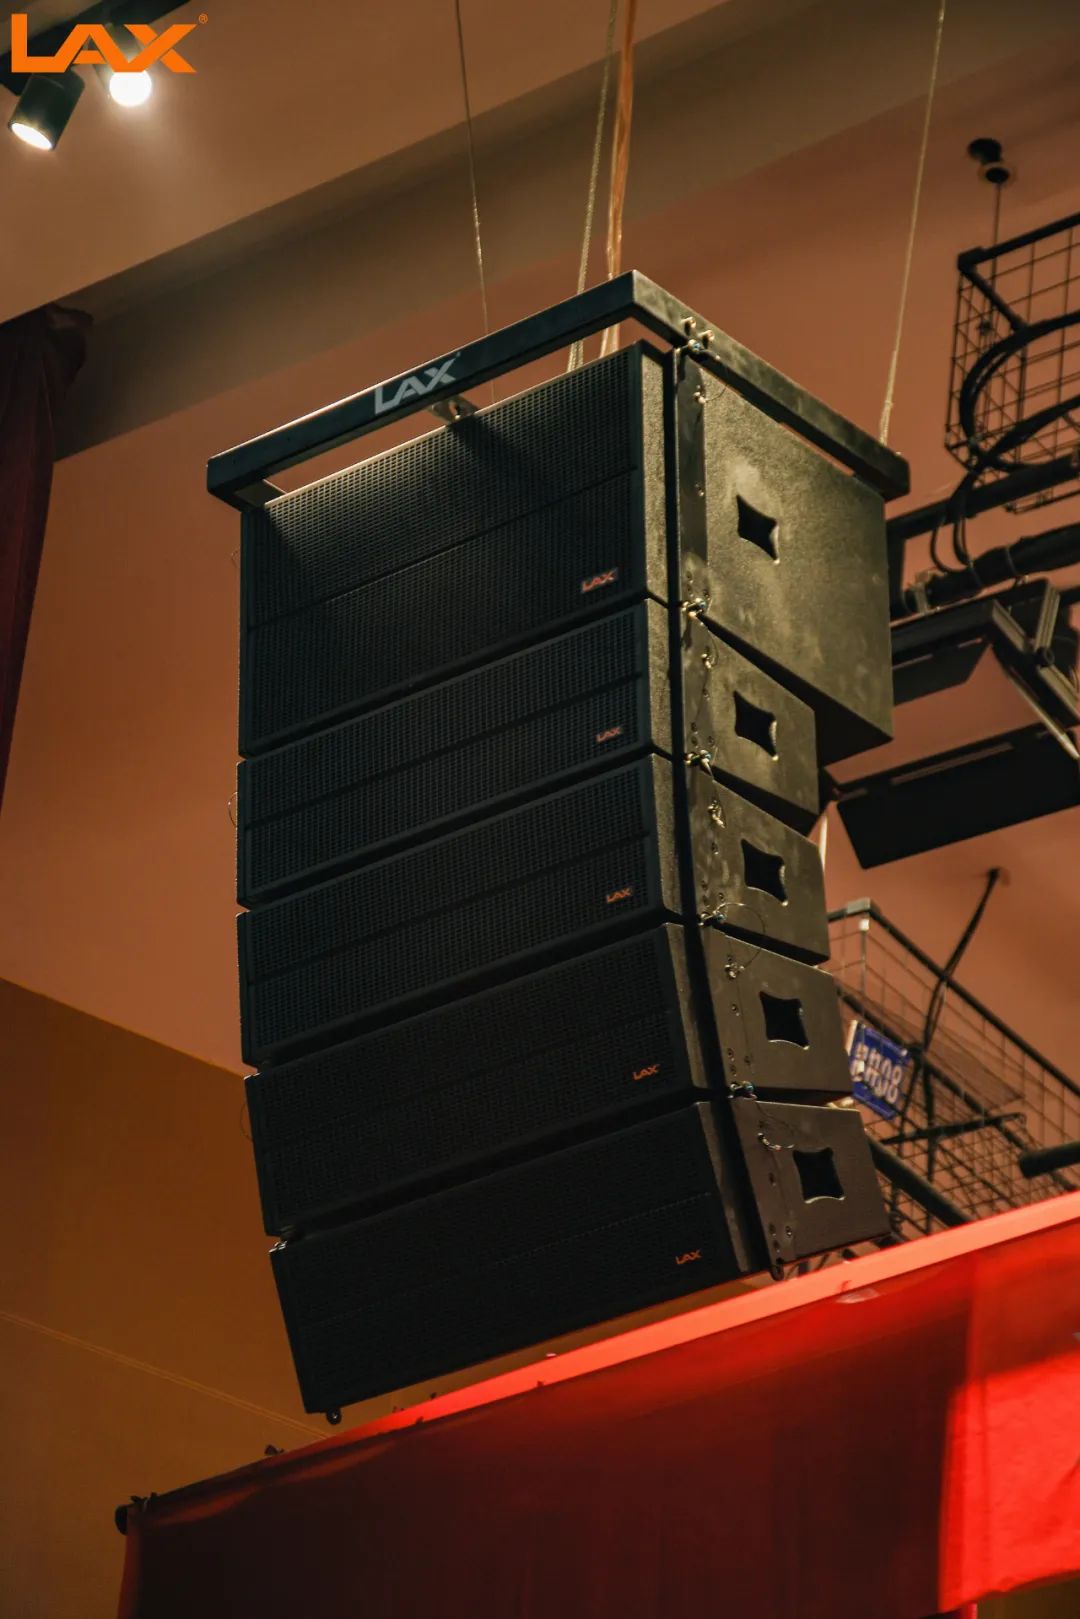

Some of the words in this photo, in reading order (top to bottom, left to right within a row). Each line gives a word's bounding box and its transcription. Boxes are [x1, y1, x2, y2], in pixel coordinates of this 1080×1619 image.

[375, 358, 456, 414] LAX
[582, 569, 616, 593] LAX
[596, 726, 622, 742] LAX
[606, 887, 631, 902] LAX
[633, 1064, 659, 1081] LAX
[675, 1249, 702, 1265] LAX
